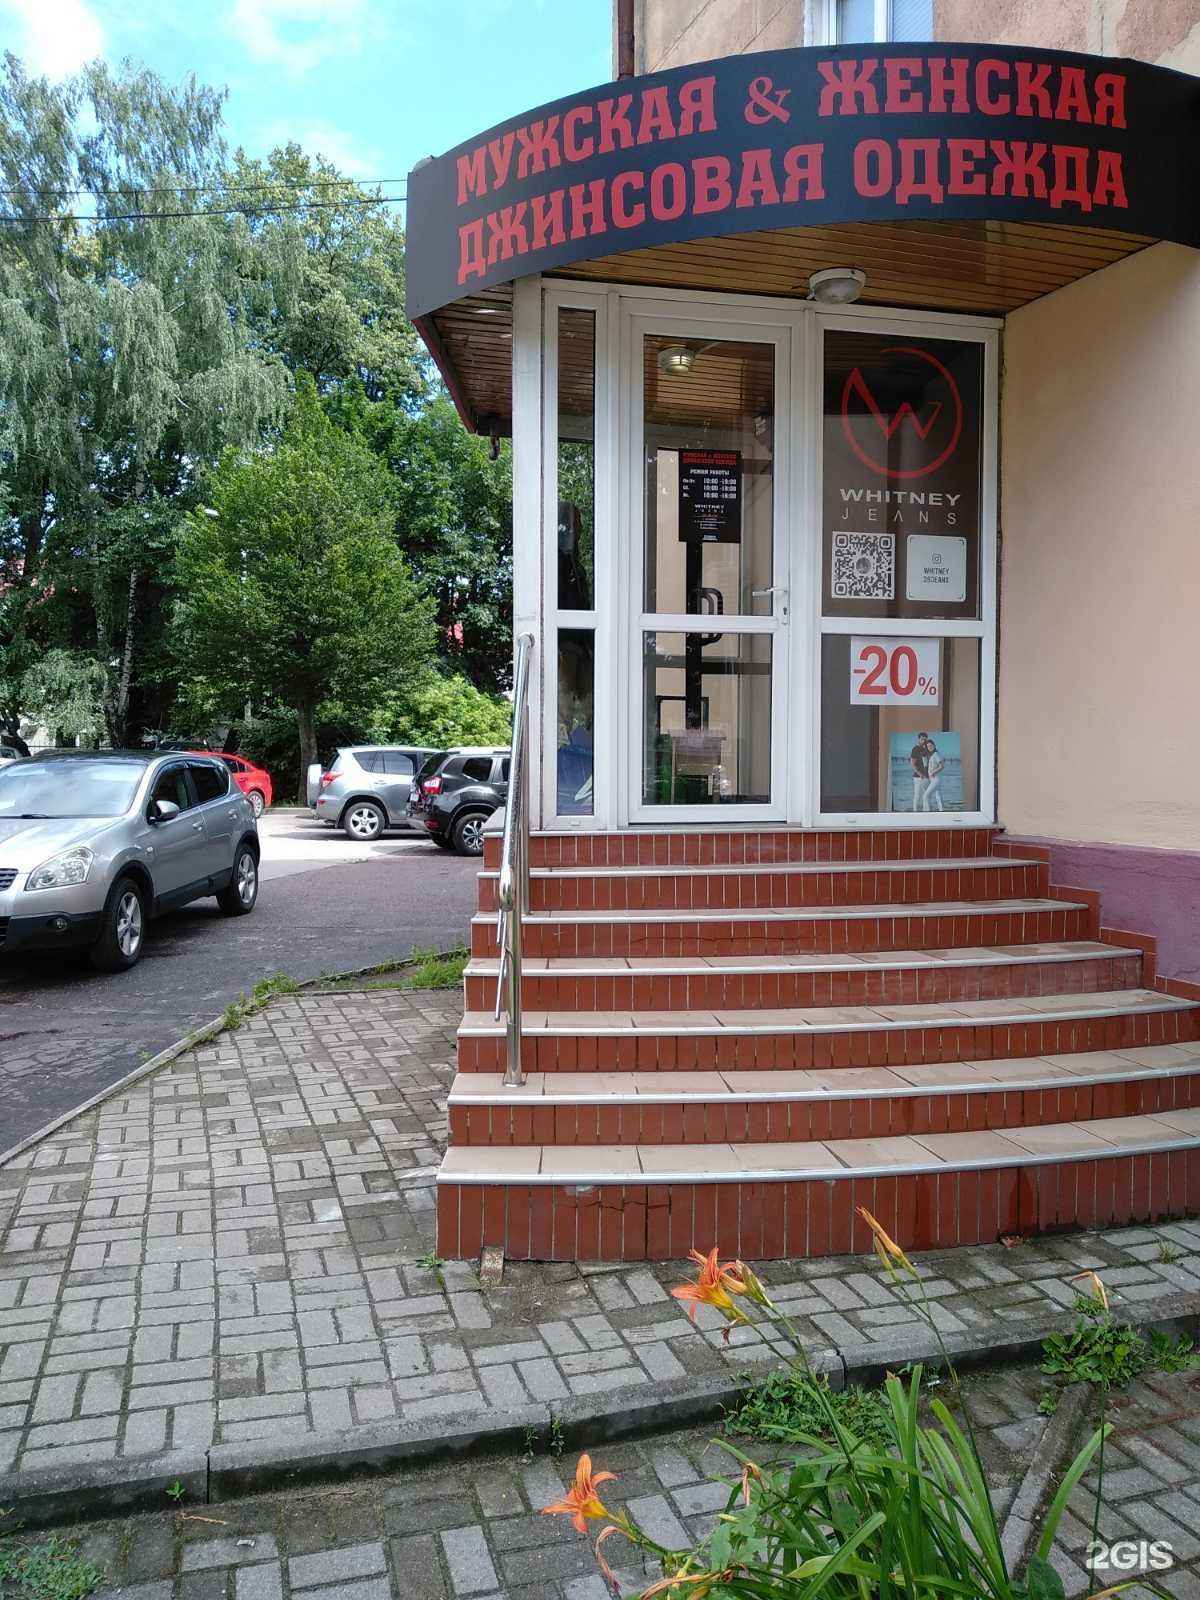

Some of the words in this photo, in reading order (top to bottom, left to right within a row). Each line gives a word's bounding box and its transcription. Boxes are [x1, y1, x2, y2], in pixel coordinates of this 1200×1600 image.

[456, 75, 718, 207] МУЖСКАЯ
[744, 76, 791, 124] &
[816, 57, 1128, 129] ЖЕНСКАЯ
[456, 143, 825, 286] ДЖИНСОВАЯ
[853, 138, 1129, 213] ОДЕЖДА
[839, 488, 961, 507] WHITNEY
[841, 508, 959, 525] JEANS
[923, 567, 950, 576] WHITNEY
[853, 645, 937, 696] -20%
